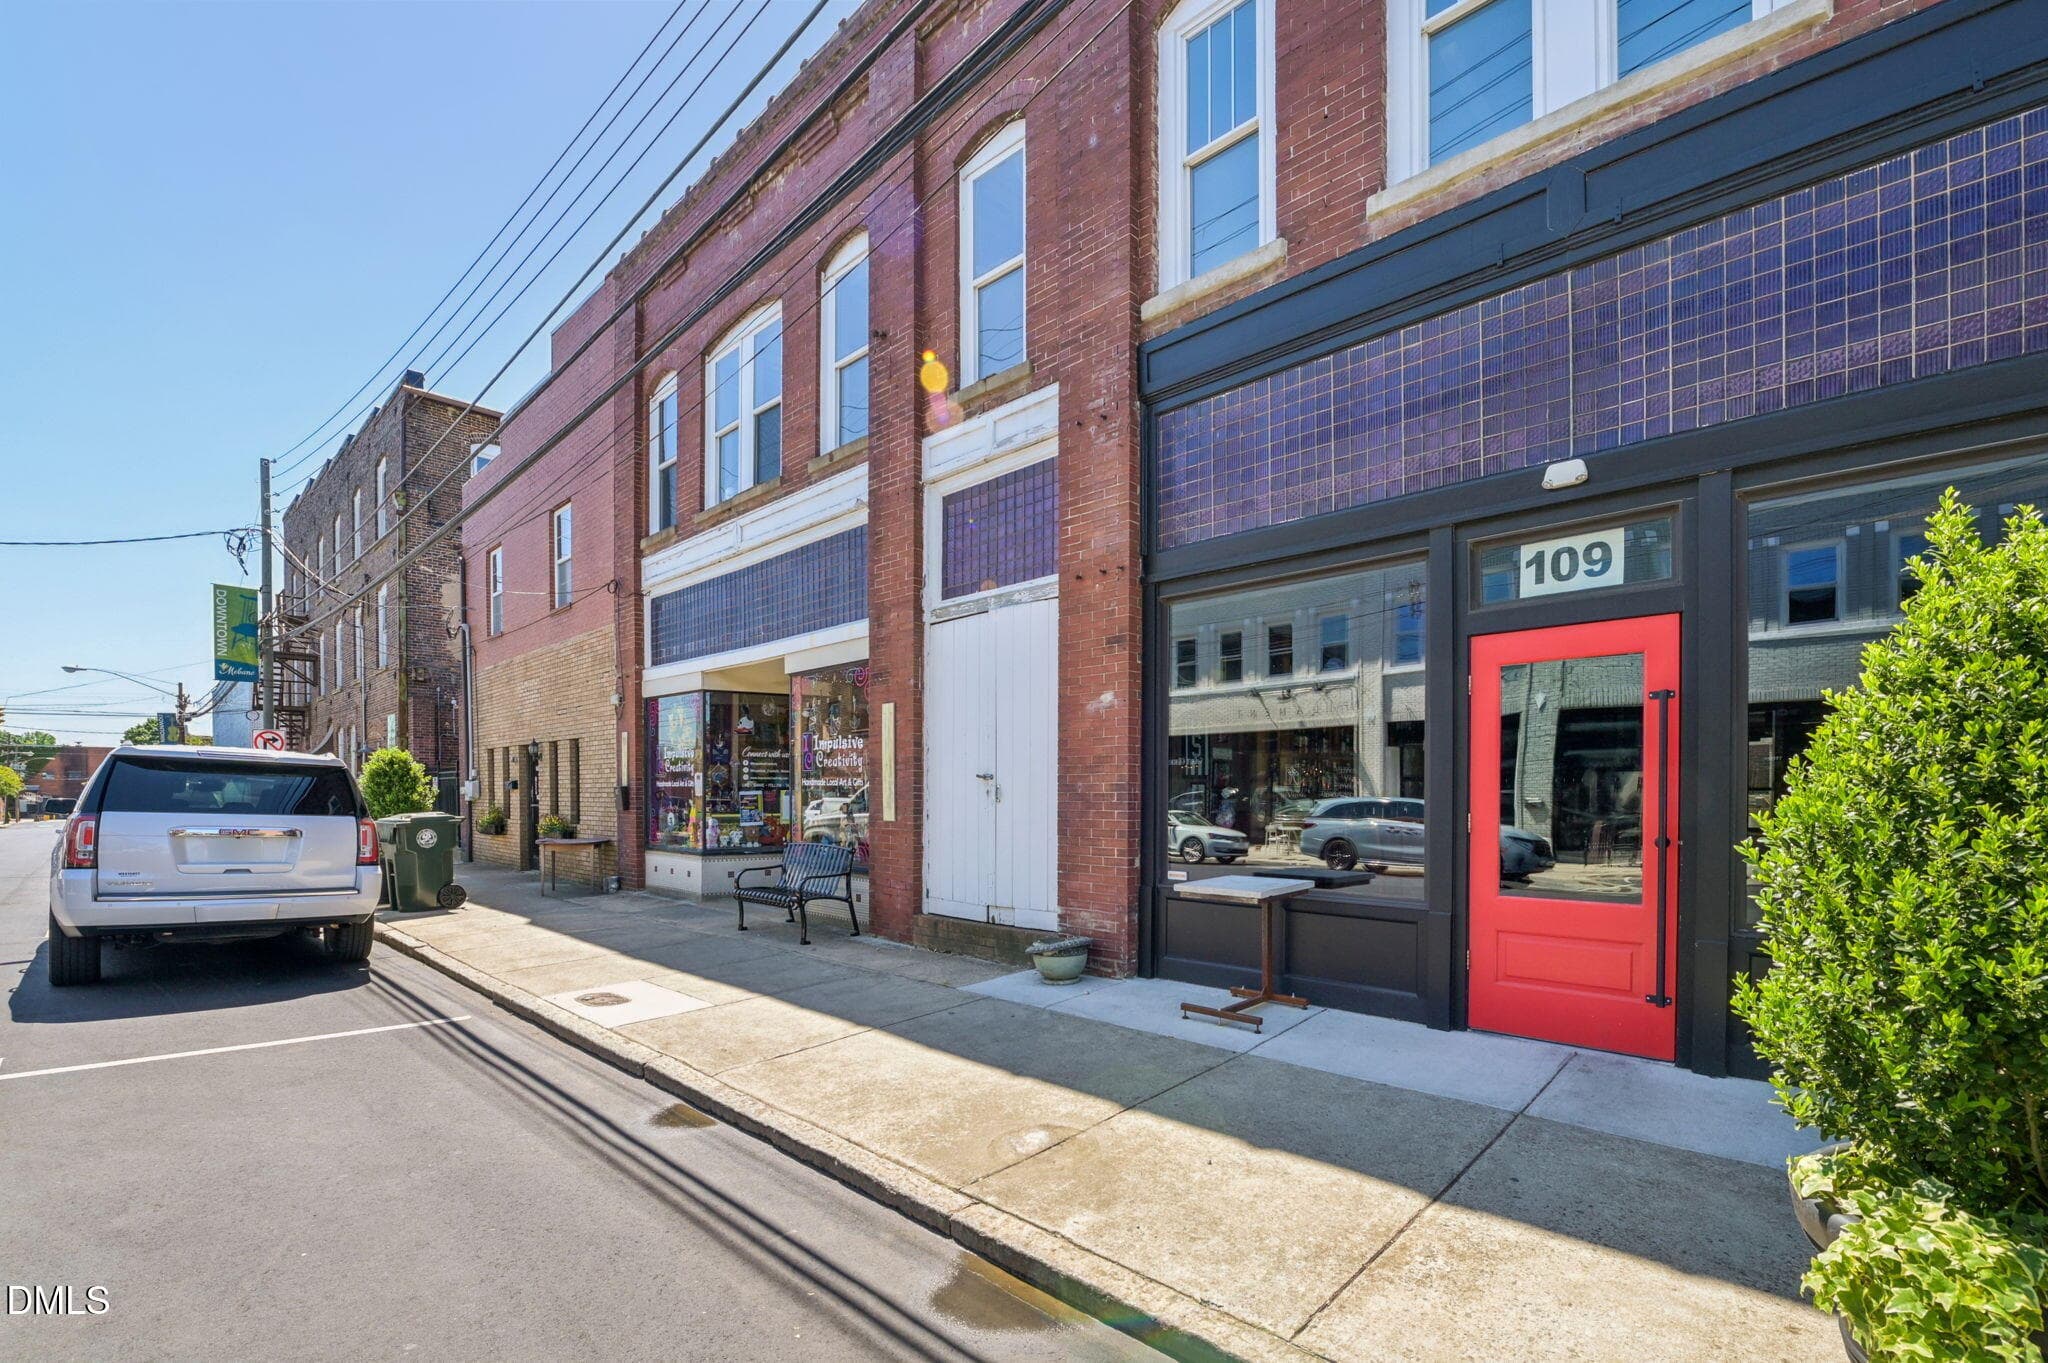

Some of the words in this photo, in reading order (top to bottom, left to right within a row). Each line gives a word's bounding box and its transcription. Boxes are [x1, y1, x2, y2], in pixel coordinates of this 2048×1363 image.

[1525, 541, 1613, 585] 109
[215, 589, 228, 656] DOWNTOWN
[219, 665, 255, 677] Mebane
[812, 734, 864, 753] Impulsive
[664, 747, 695, 761] Impulsive
[741, 745, 767, 758] Connect
[768, 749, 781, 758] with
[664, 759, 695, 776] Creativity
[815, 751, 863, 773] Creativity
[802, 778, 826, 787] Handmade
[826, 778, 838, 787] Local
[838, 778, 848, 787] Art
[219, 828, 260, 836] GMC
